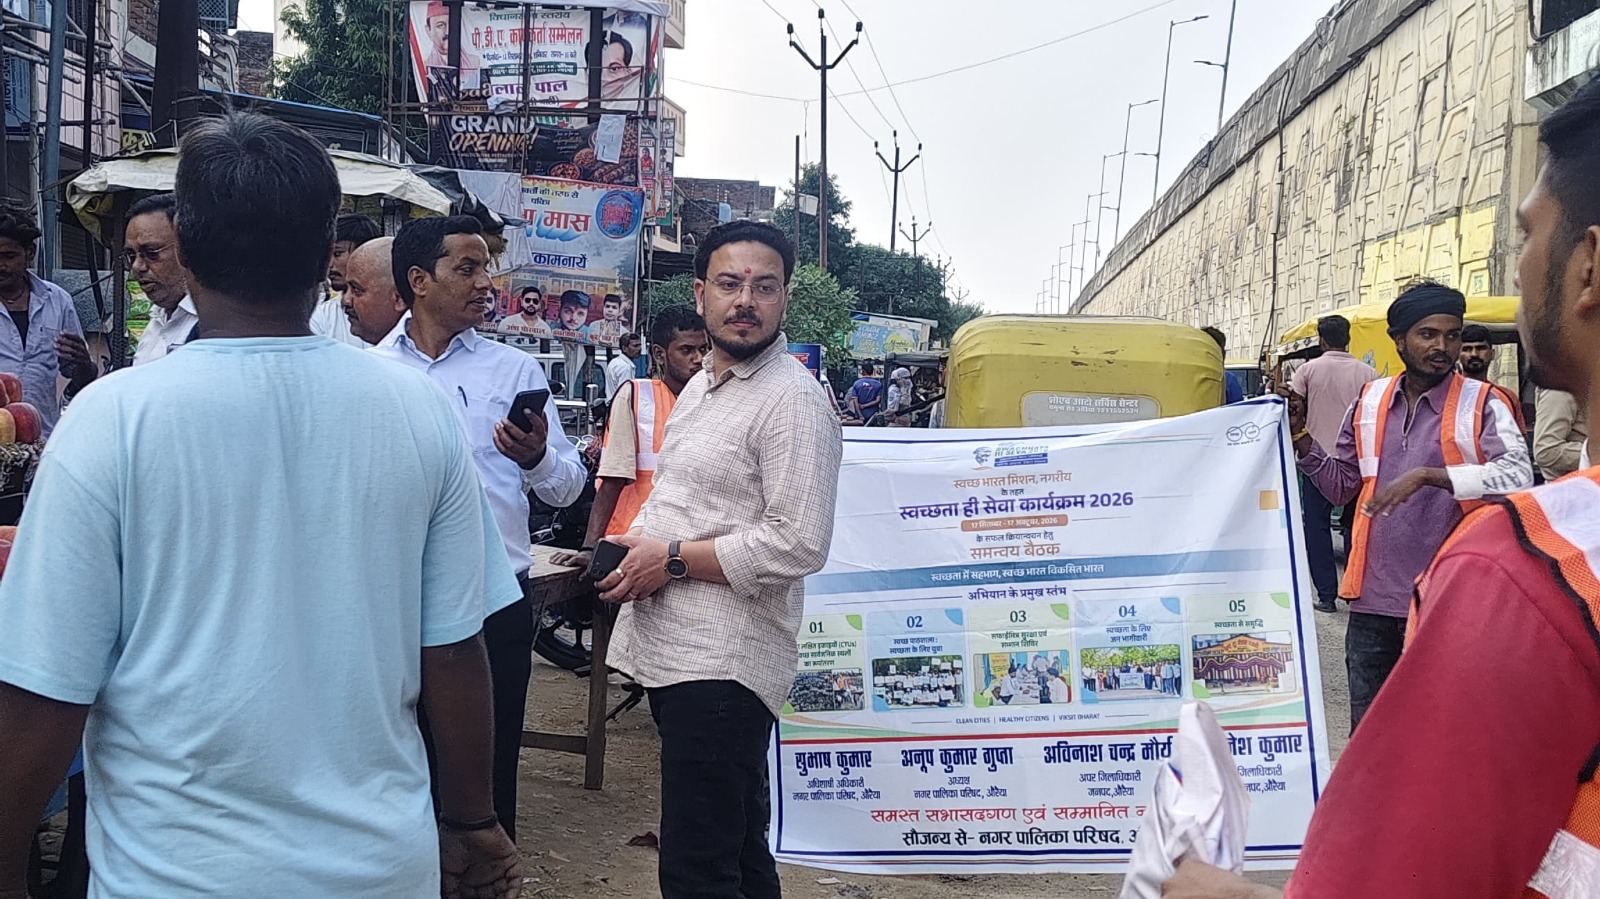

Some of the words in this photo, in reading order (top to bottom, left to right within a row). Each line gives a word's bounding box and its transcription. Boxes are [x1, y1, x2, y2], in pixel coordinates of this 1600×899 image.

[548, 22, 583, 45] सम्मेलन
[534, 80, 568, 94] पाल
[451, 115, 536, 133] GRAND
[544, 210, 592, 233] मास
[532, 252, 588, 269] कामनायें
[954, 478, 980, 489] स्वच्छ
[982, 476, 1007, 487] भारत
[1009, 473, 1038, 486] मिशन,
[1040, 471, 1072, 484] नगरीय
[1001, 488, 1008, 496] के
[1009, 488, 1024, 496] तहत
[900, 502, 959, 520] स्वच्छता
[963, 496, 979, 517] ही
[983, 495, 1015, 513] सेवा
[1019, 491, 1086, 512] कार्यक्रम
[1090, 492, 1134, 508] 2026
[1041, 517, 1058, 525] 2026
[976, 534, 983, 543] के
[984, 534, 1004, 543] सफल
[1005, 532, 1042, 542] क्रियान्वयन
[1043, 531, 1054, 541] हेतु
[970, 545, 1020, 560] समन्वय
[1024, 540, 1061, 557] बैठक
[931, 572, 962, 582] स्वच्छता
[962, 569, 970, 580] में
[971, 569, 1001, 580] सहभाग,
[1002, 568, 1025, 577] स्वच्छ
[1026, 567, 1046, 576] भारत
[1047, 564, 1082, 575] विकसित
[1083, 563, 1104, 573] भारत
[968, 587, 1006, 601] अभियान
[1008, 586, 1018, 598] के
[1020, 587, 1044, 601] प्रमुख
[1045, 585, 1067, 597] स्तंभ
[1118, 604, 1137, 617] 04
[1229, 599, 1246, 613] 05
[906, 615, 923, 628] 02
[1009, 610, 1027, 623] 03
[809, 621, 824, 633] 01
[1106, 626, 1129, 634] स्वच्छता
[1138, 623, 1152, 632] लिए
[1214, 620, 1237, 628] स्वच्छता
[1110, 635, 1120, 643] जन
[1121, 633, 1148, 642] भागीदारी
[918, 645, 931, 653] लिए
[1044, 740, 1103, 765] अविनाश
[1108, 742, 1136, 763] चन्द्र
[1258, 734, 1303, 762] कुमार
[795, 751, 831, 776] सुभाष
[836, 750, 872, 775] कुमार
[901, 748, 934, 773] अनूप
[939, 747, 978, 773] कुमार
[982, 746, 1013, 772] गुप्ता
[836, 776, 865, 788] अधिकारी
[1079, 772, 1096, 783] अपर
[1098, 769, 1141, 782] जिलाधिकारी
[792, 791, 809, 801] नगर
[810, 790, 834, 801] पालिका
[836, 789, 859, 801] परिषद,
[861, 788, 881, 800] औरैया
[913, 790, 931, 799] नगर
[933, 788, 958, 799] पालिका
[960, 788, 984, 800] परिषद,
[986, 785, 1007, 798] औरैया
[870, 808, 920, 823] समस्त
[925, 807, 1017, 823] सभासदगण
[1022, 803, 1047, 824] एवं
[1053, 801, 1130, 821] सम्मानित
[902, 828, 951, 846] सौजन्य
[978, 830, 1012, 846] नगर
[1016, 827, 1069, 845] पालिका
[1073, 825, 1124, 846] परिषद,
